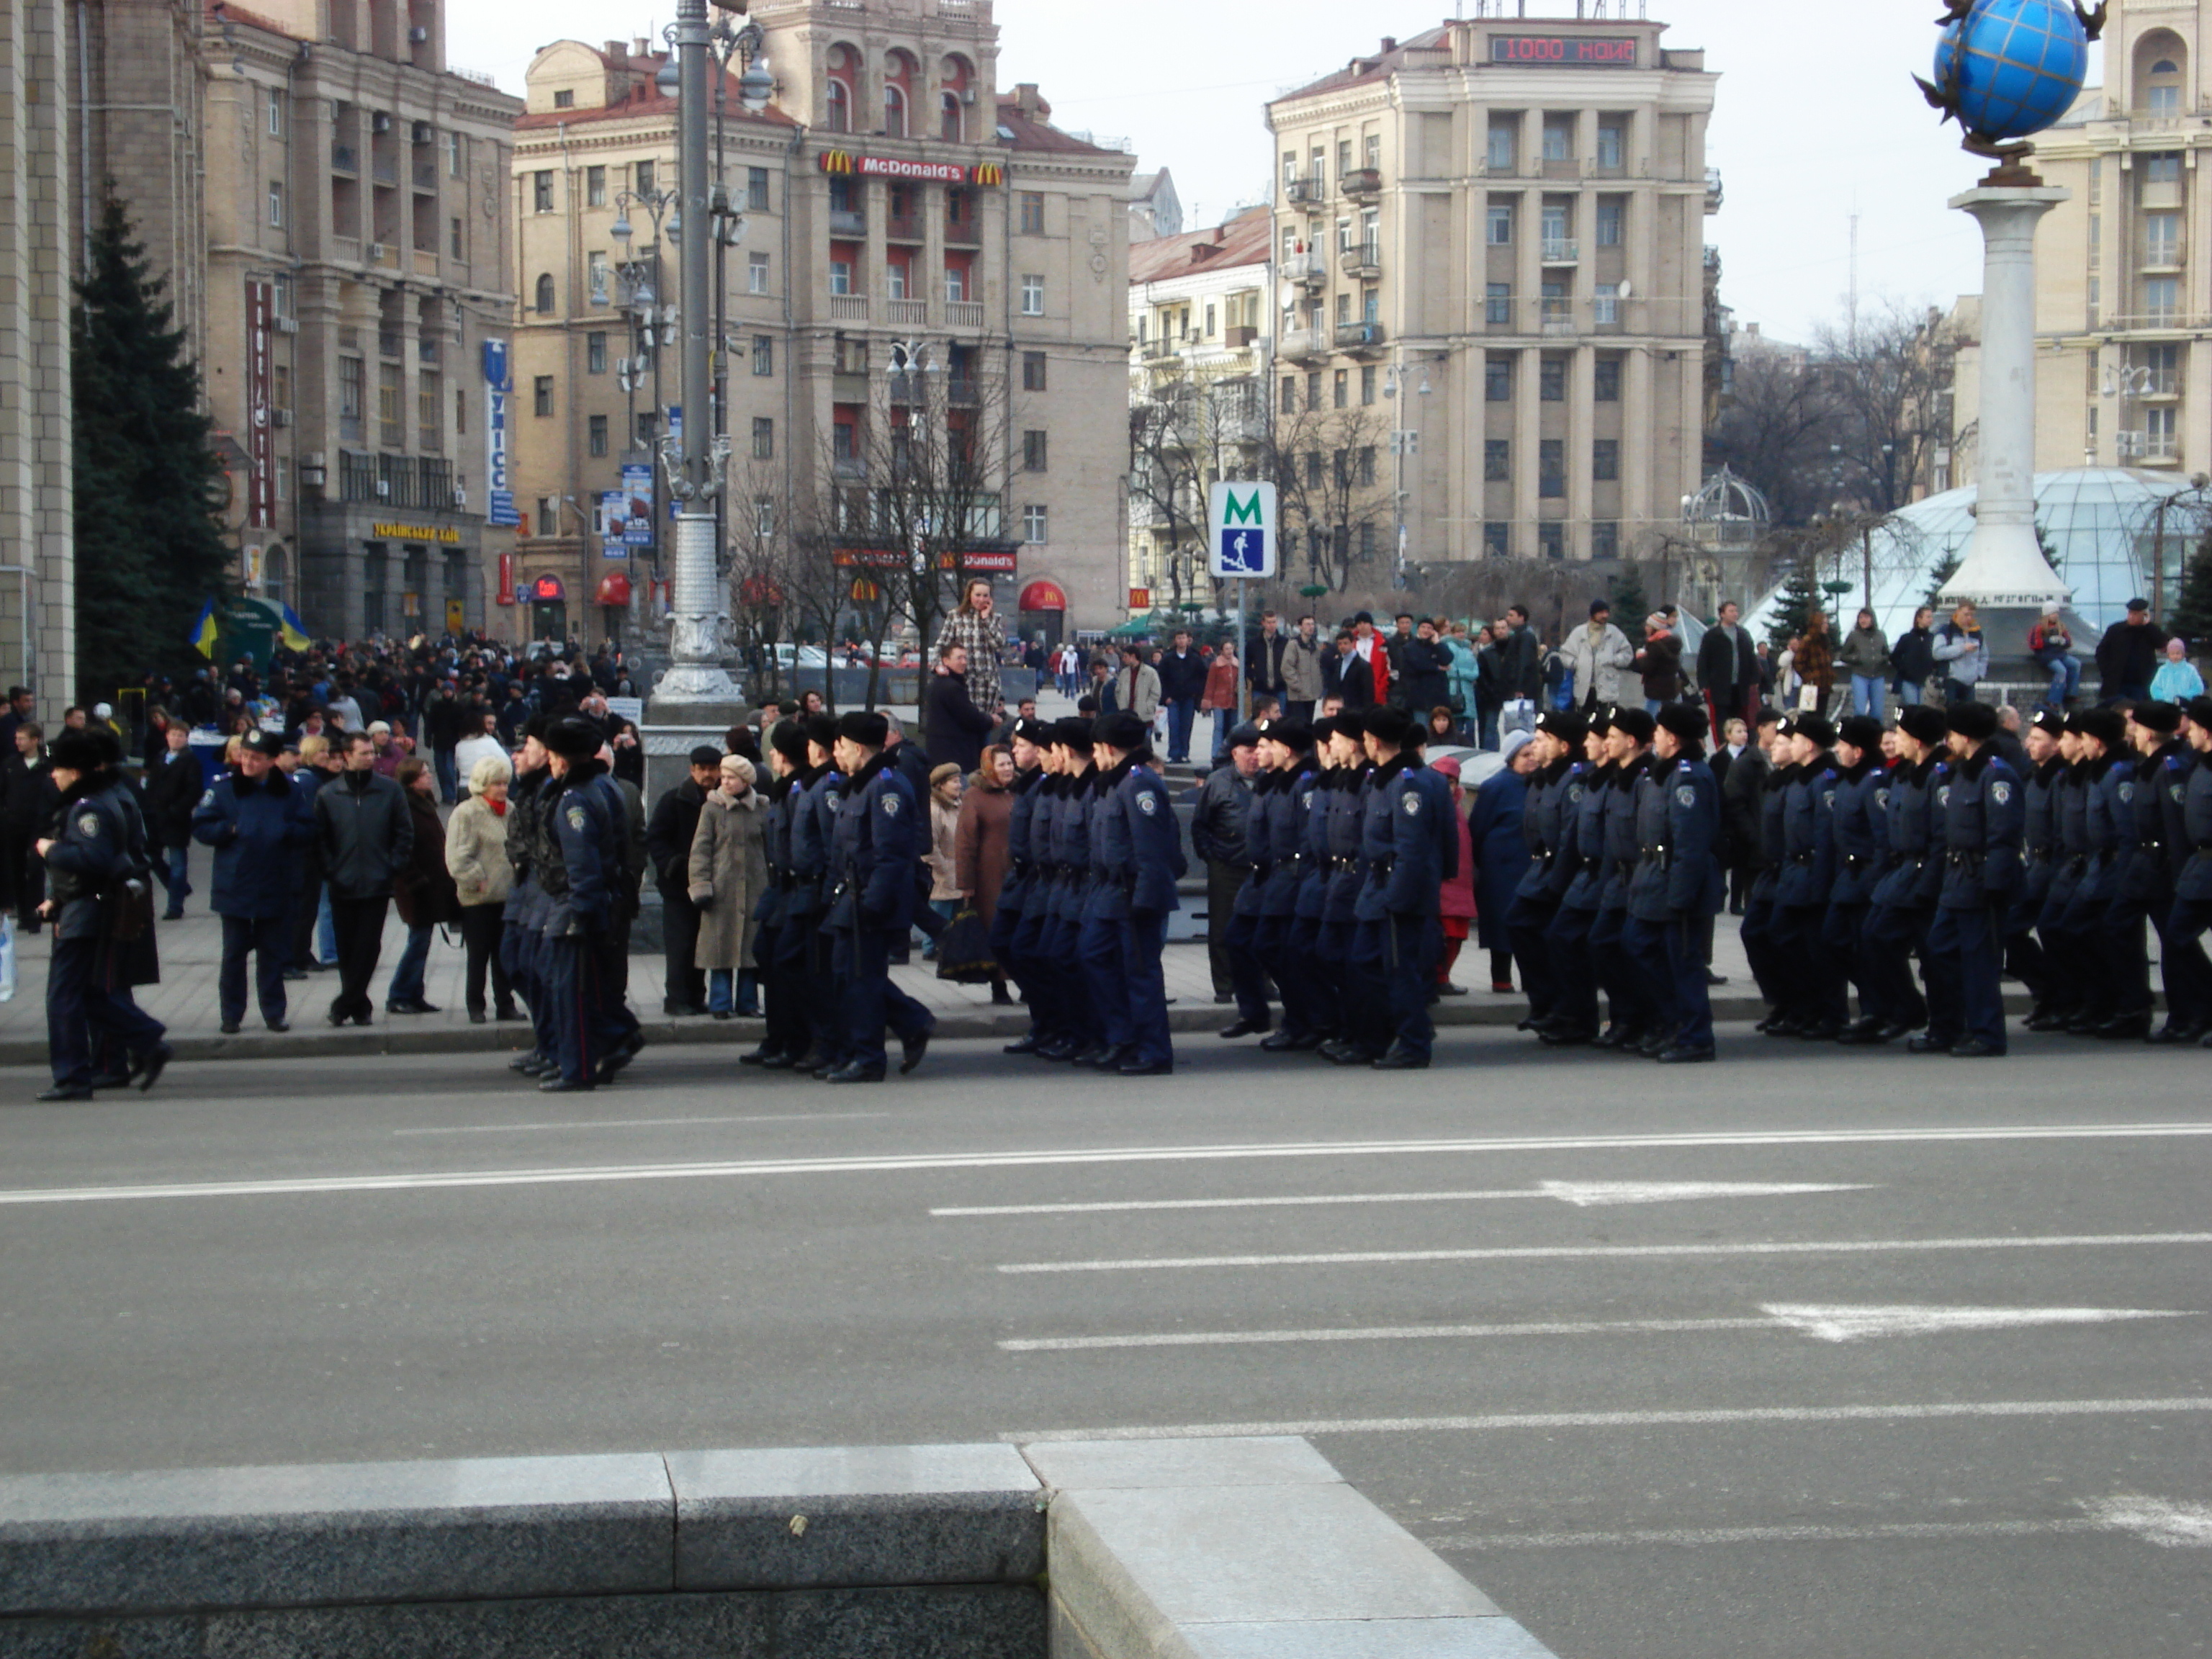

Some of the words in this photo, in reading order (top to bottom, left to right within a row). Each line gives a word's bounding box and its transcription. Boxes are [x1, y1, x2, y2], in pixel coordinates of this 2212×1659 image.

[1507, 39, 1564, 59] 1000
[863, 158, 961, 180] McDonald's
[964, 555, 1013, 567] Donald's
